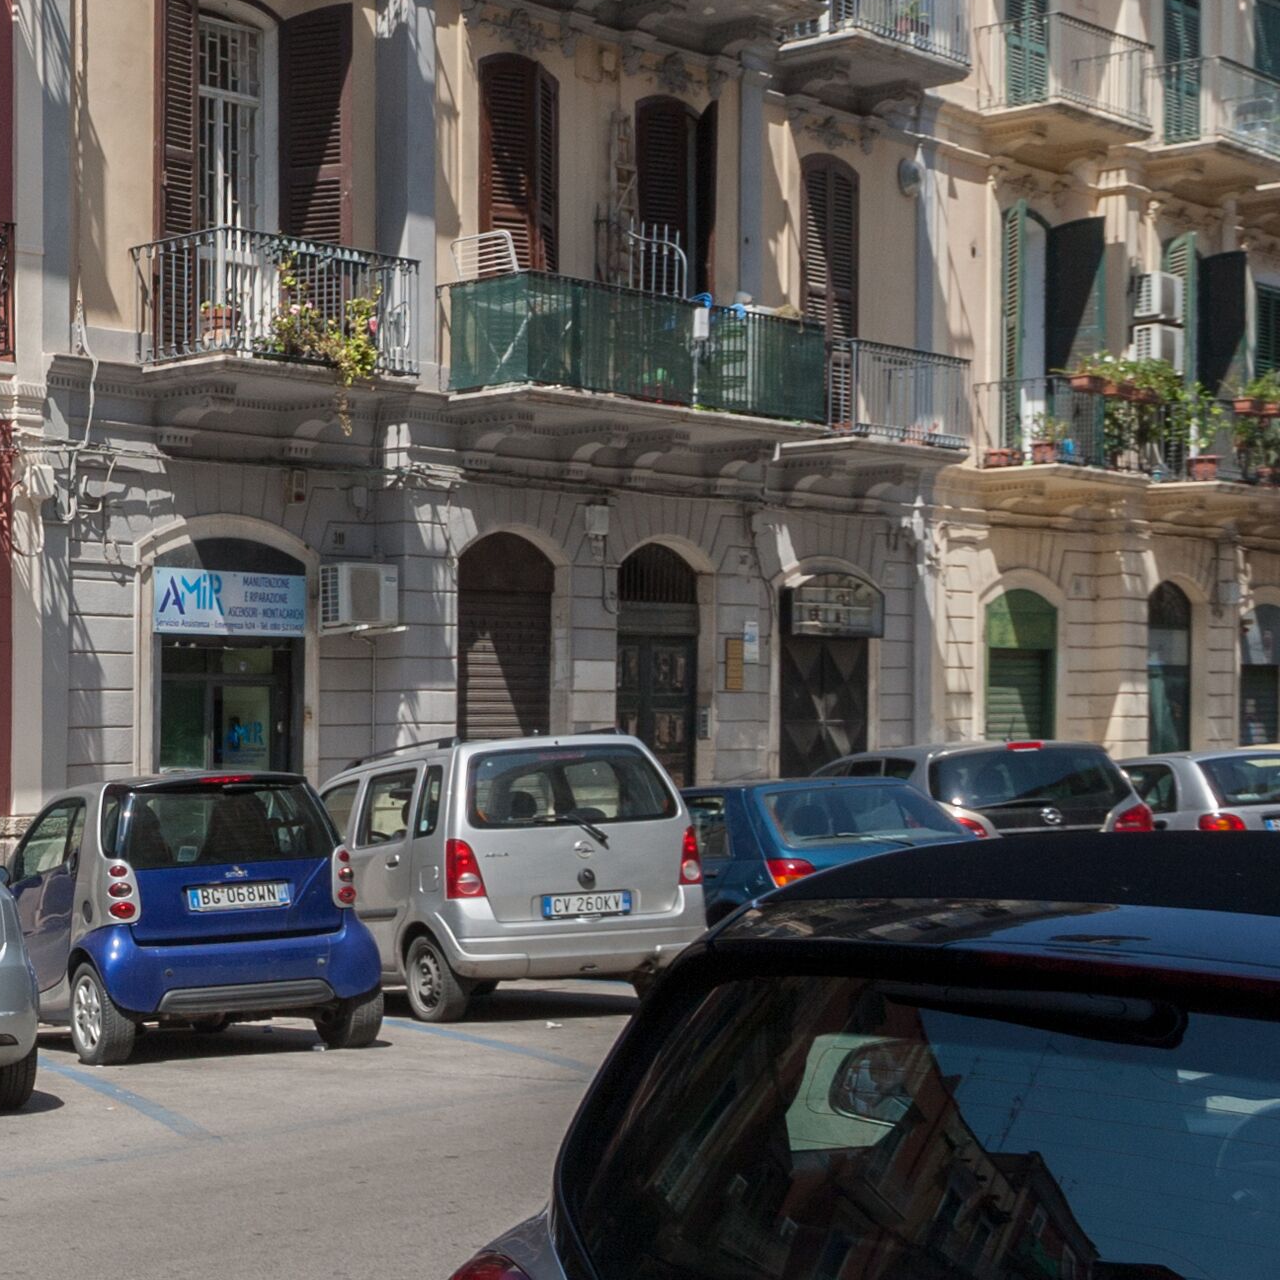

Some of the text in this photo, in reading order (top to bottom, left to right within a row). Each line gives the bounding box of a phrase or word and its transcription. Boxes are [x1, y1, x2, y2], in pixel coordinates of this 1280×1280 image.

[242, 576, 290, 589] MANUTENZIONE
[249, 593, 288, 604] RIPARAZIONE
[201, 884, 277, 905] BG 068WN
[553, 895, 621, 913] CV 260KV
